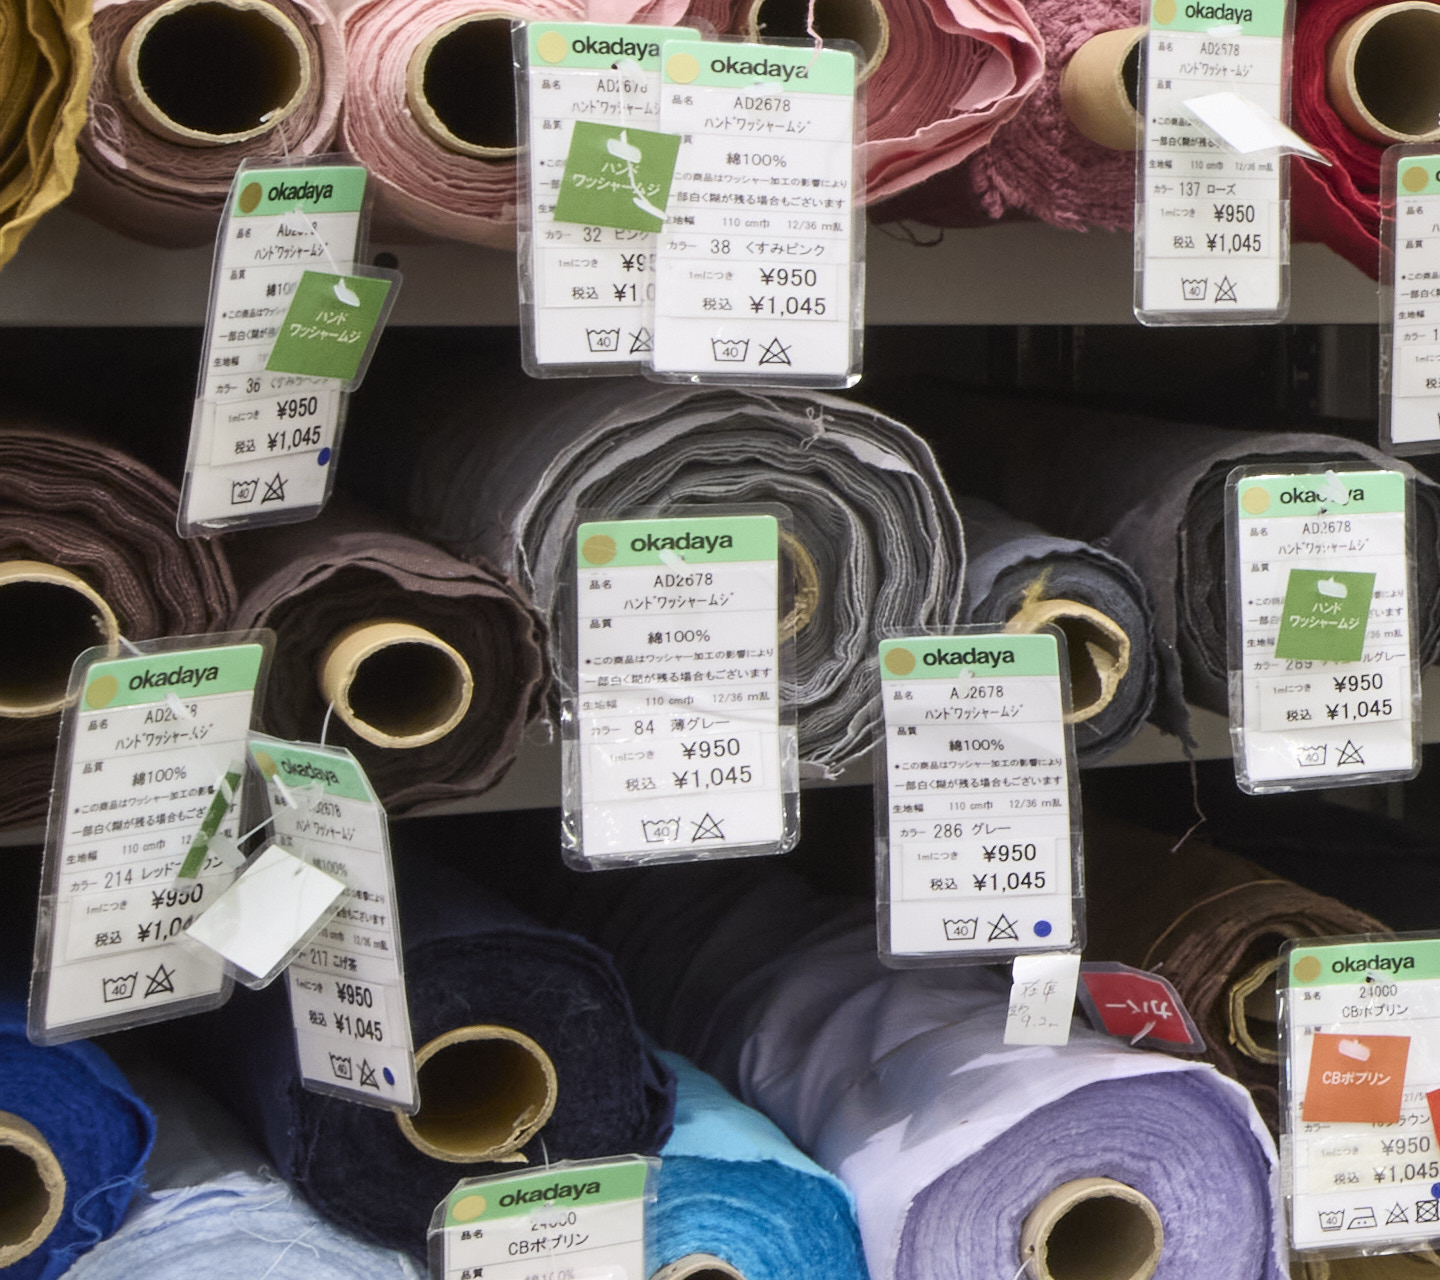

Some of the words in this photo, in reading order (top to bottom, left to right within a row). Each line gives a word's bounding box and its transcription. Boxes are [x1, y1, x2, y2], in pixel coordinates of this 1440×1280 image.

[711, 56, 808, 82] okadaya
[734, 96, 790, 112] AD2678
[726, 152, 786, 167] 綿100%
[268, 181, 333, 204] okadaya
[760, 268, 816, 286] ¥950
[703, 298, 732, 310] 税込
[750, 296, 825, 316] ¥1,045
[277, 396, 317, 420] ¥950
[234, 439, 256, 454] 税込
[268, 425, 321, 451] ¥1,045
[631, 532, 732, 553] okadaya
[923, 647, 1015, 668] okadaya
[634, 720, 654, 735] 84
[671, 717, 729, 731] 薄グレー
[681, 738, 740, 759] ¥950
[625, 777, 656, 791] 税込
[673, 765, 751, 788] ¥1,045
[983, 844, 1036, 862] ¥950
[930, 878, 957, 890] 税込
[973, 872, 1045, 892] ¥1,045
[499, 1182, 600, 1207] okadaya
